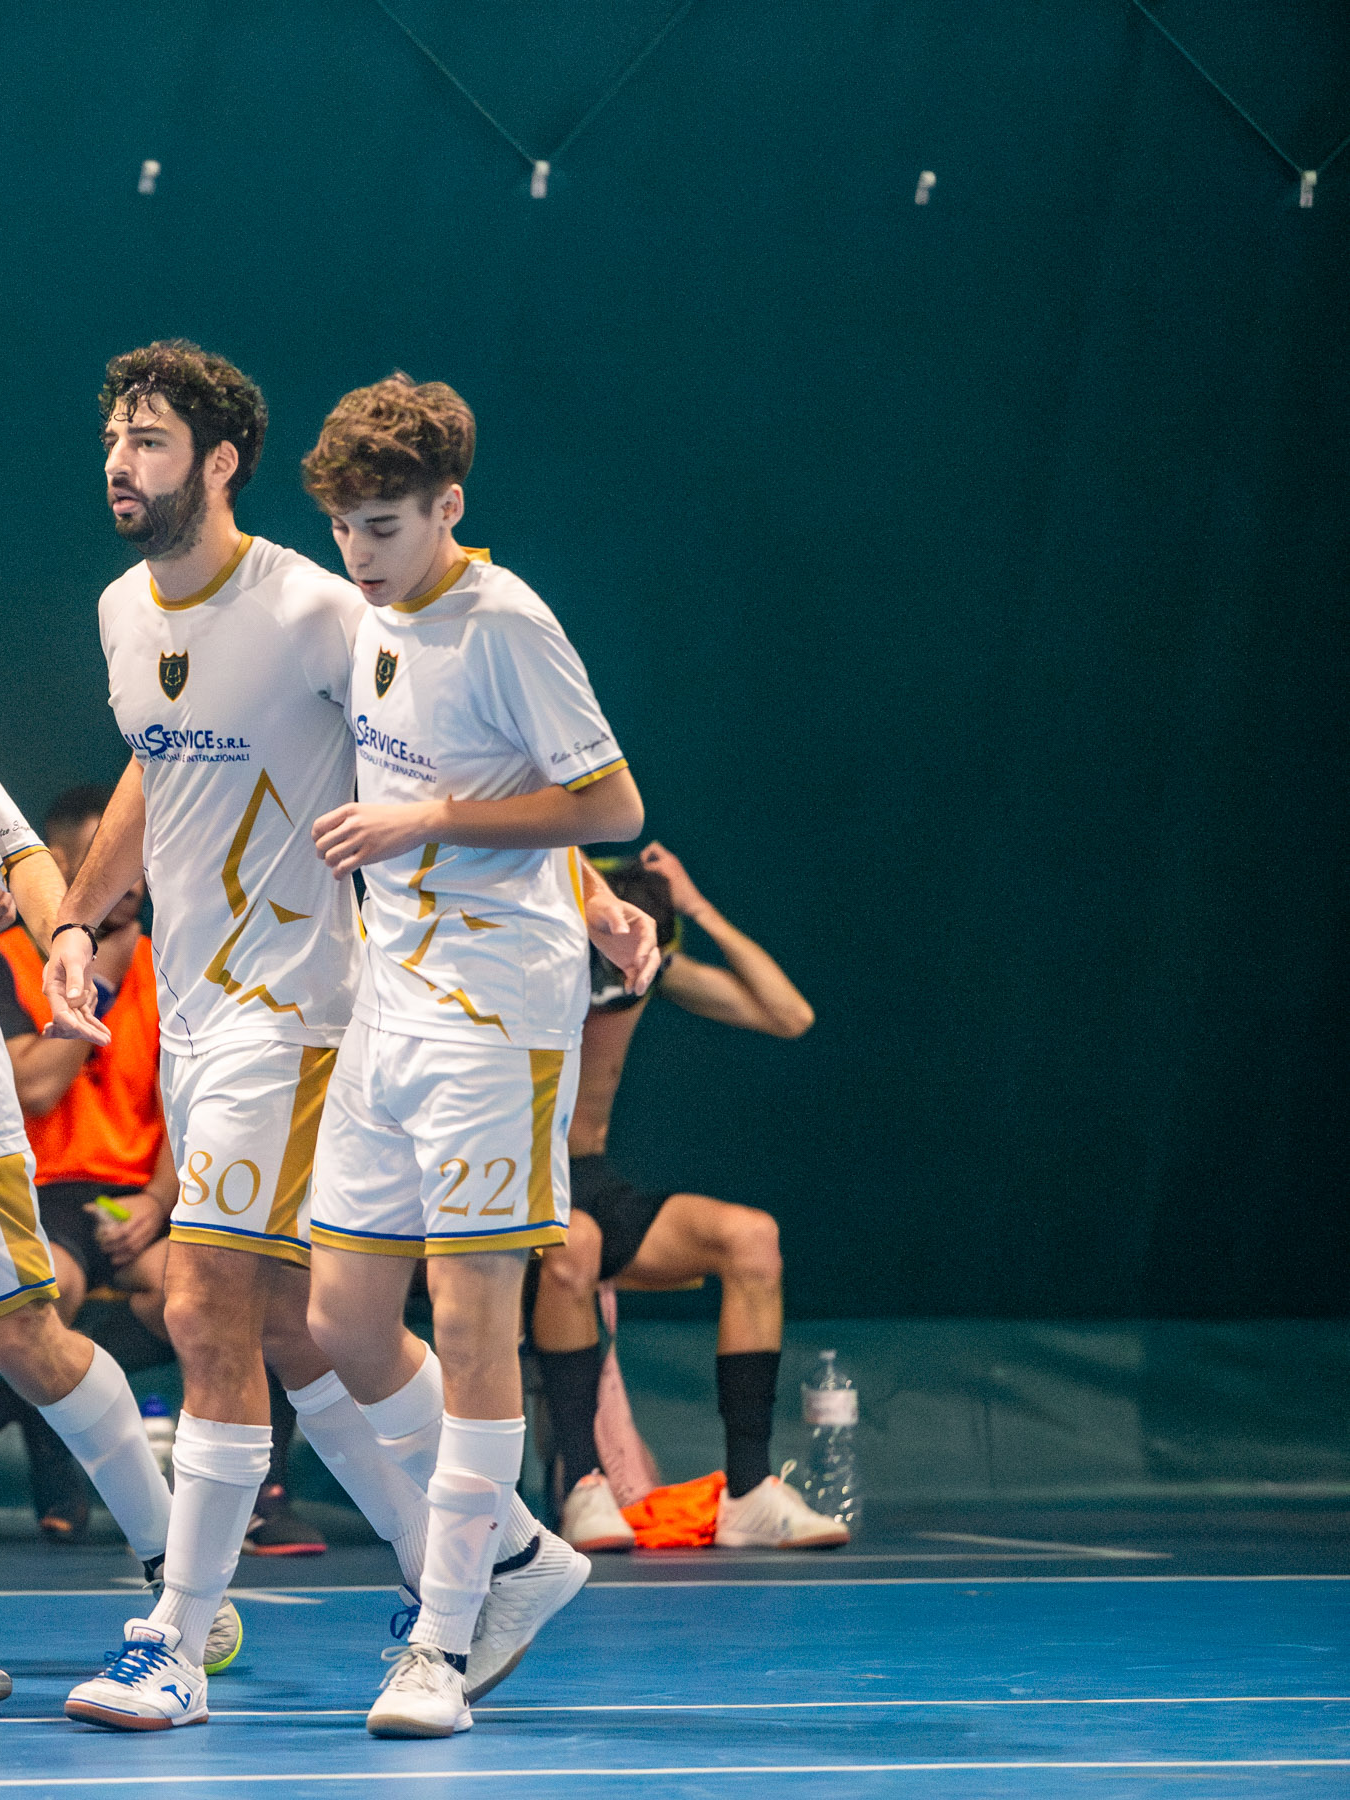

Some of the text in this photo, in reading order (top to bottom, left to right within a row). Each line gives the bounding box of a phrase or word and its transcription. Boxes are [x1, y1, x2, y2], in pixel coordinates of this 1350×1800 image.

[216, 737, 251, 750] S.R.L.
[180, 1150, 261, 1216] 80
[437, 1157, 517, 1217] 22
